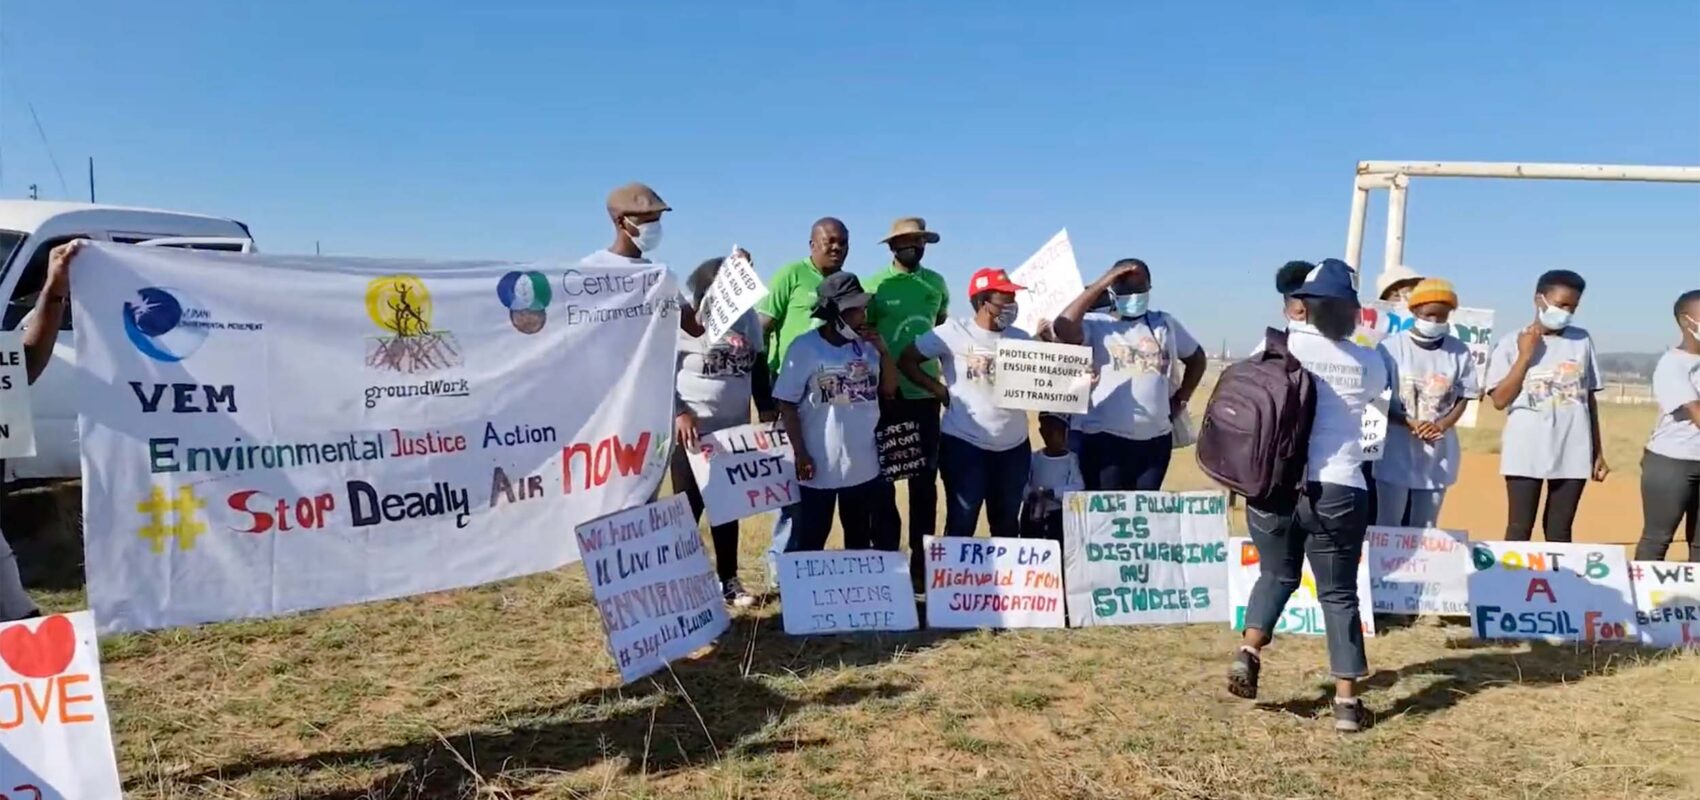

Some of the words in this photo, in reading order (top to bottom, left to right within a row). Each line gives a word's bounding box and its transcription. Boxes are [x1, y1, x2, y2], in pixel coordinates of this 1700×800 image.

[563, 268, 634, 296] Centre
[0, 351, 20, 366] LE
[1000, 348, 1038, 360] PROTECT
[1040, 351, 1056, 363] THE
[1058, 354, 1088, 366] PEOPLE
[1004, 361, 1037, 373] ENSURE
[1039, 365, 1083, 377] MEASURES
[365, 380, 469, 409] groundWork
[1034, 378, 1046, 388] TO
[1047, 380, 1053, 389] A
[128, 381, 238, 413] VEM
[1004, 389, 1025, 399] JUST
[1027, 391, 1079, 402] TRANSITION
[149, 430, 383, 473] Environmental
[390, 428, 467, 458] Justice
[482, 421, 556, 448] Action
[346, 480, 470, 529] Deadly
[563, 431, 651, 495] now
[726, 455, 785, 486] MUST
[746, 480, 792, 508] PAY
[1089, 494, 1127, 513] AIR
[1135, 494, 1226, 515] POLLUTION
[1112, 516, 1150, 539] IS
[1018, 546, 1052, 566] the
[1086, 542, 1228, 563] DISTURBING
[1472, 547, 1565, 572] DONT
[1576, 552, 1610, 579] B
[795, 556, 885, 579] HEALTHY
[931, 567, 1014, 590] Highveld
[1652, 564, 1695, 584] WE
[812, 585, 893, 607] LIVING
[1525, 577, 1558, 603] A
[949, 593, 1058, 612] SUFFOCATION
[1092, 586, 1211, 618] STUDIES
[812, 613, 837, 630] IS
[848, 611, 895, 629] LIFE
[1476, 605, 1579, 641] FOSSIL
[1636, 605, 1700, 625] BEFOR
